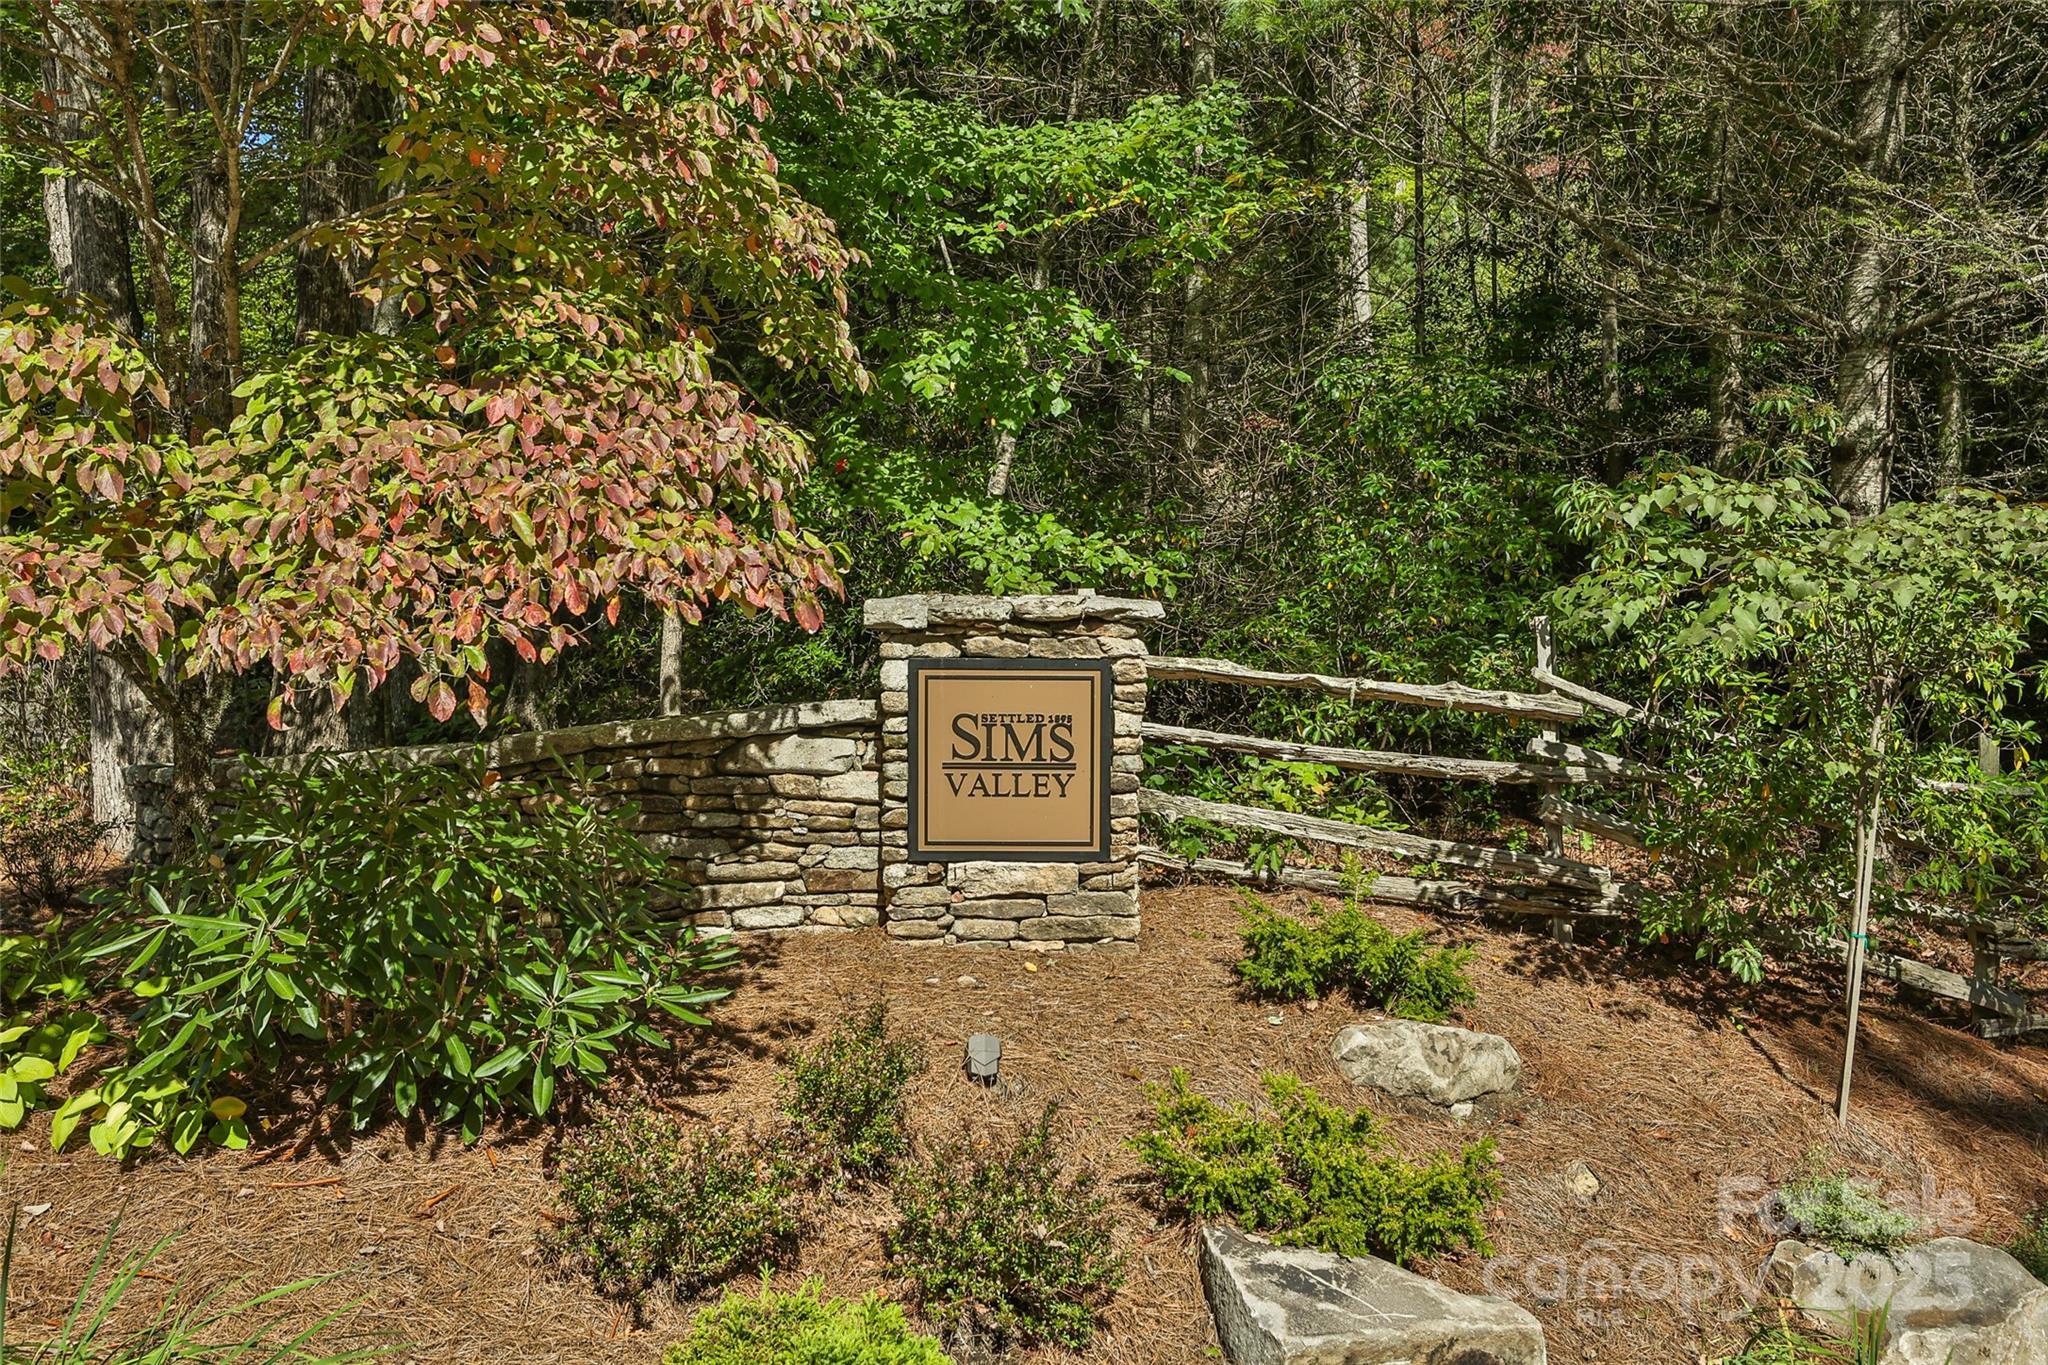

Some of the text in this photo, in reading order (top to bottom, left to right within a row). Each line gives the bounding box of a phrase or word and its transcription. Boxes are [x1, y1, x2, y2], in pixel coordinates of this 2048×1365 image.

[981, 713, 1045, 723] SETTLED
[951, 713, 1075, 763] SIMS
[944, 773, 1076, 798] VALLEY
